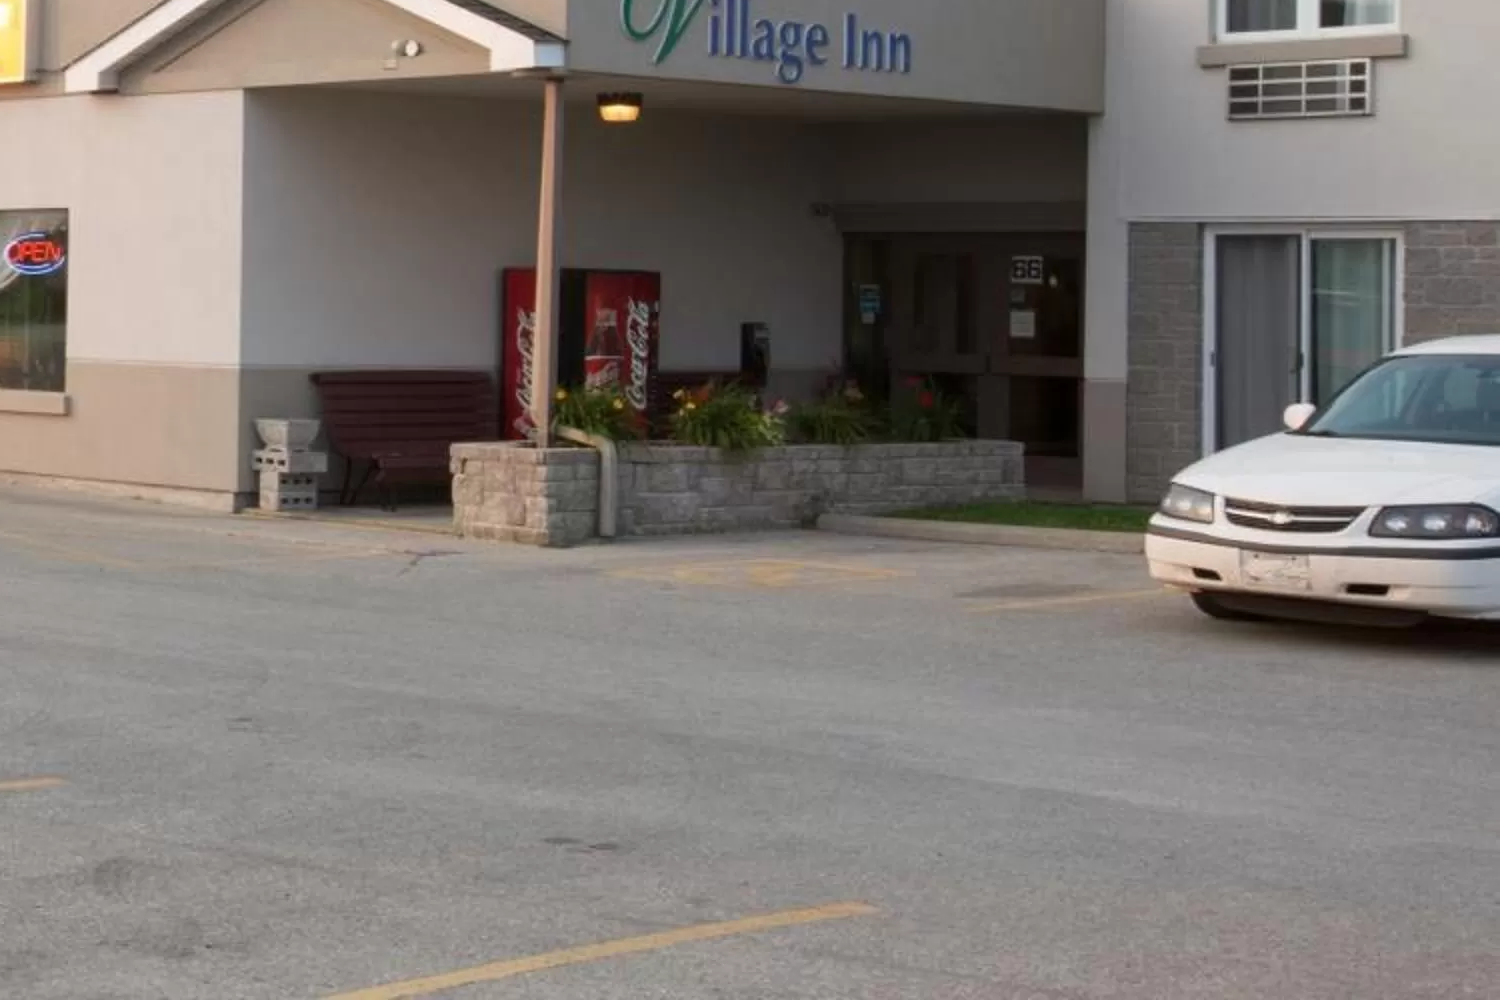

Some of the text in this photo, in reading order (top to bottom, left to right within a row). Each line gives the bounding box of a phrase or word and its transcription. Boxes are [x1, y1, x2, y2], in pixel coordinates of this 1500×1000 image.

[842, 12, 912, 74] Inn
[10, 241, 61, 262] OPEN
[1013, 259, 1042, 280] 66
